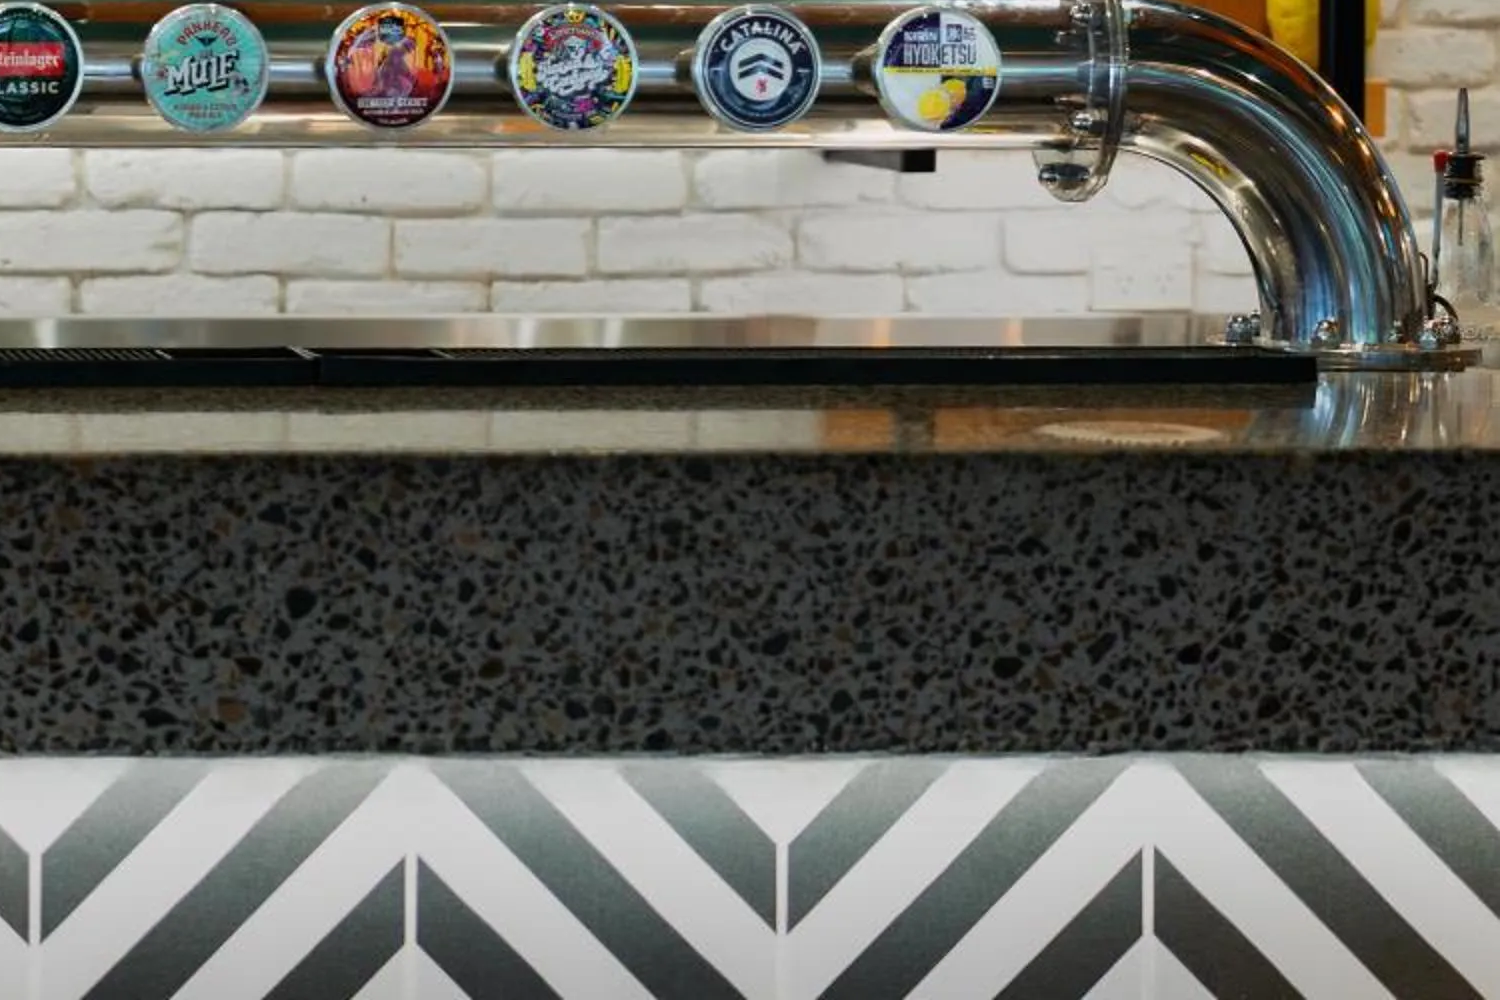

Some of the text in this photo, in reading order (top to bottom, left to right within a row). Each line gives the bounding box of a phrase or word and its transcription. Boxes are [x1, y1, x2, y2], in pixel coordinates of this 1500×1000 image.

[176, 21, 237, 46] PANHEAD
[720, 21, 807, 54] CATALINA
[904, 43, 977, 65] HYOKETSU
